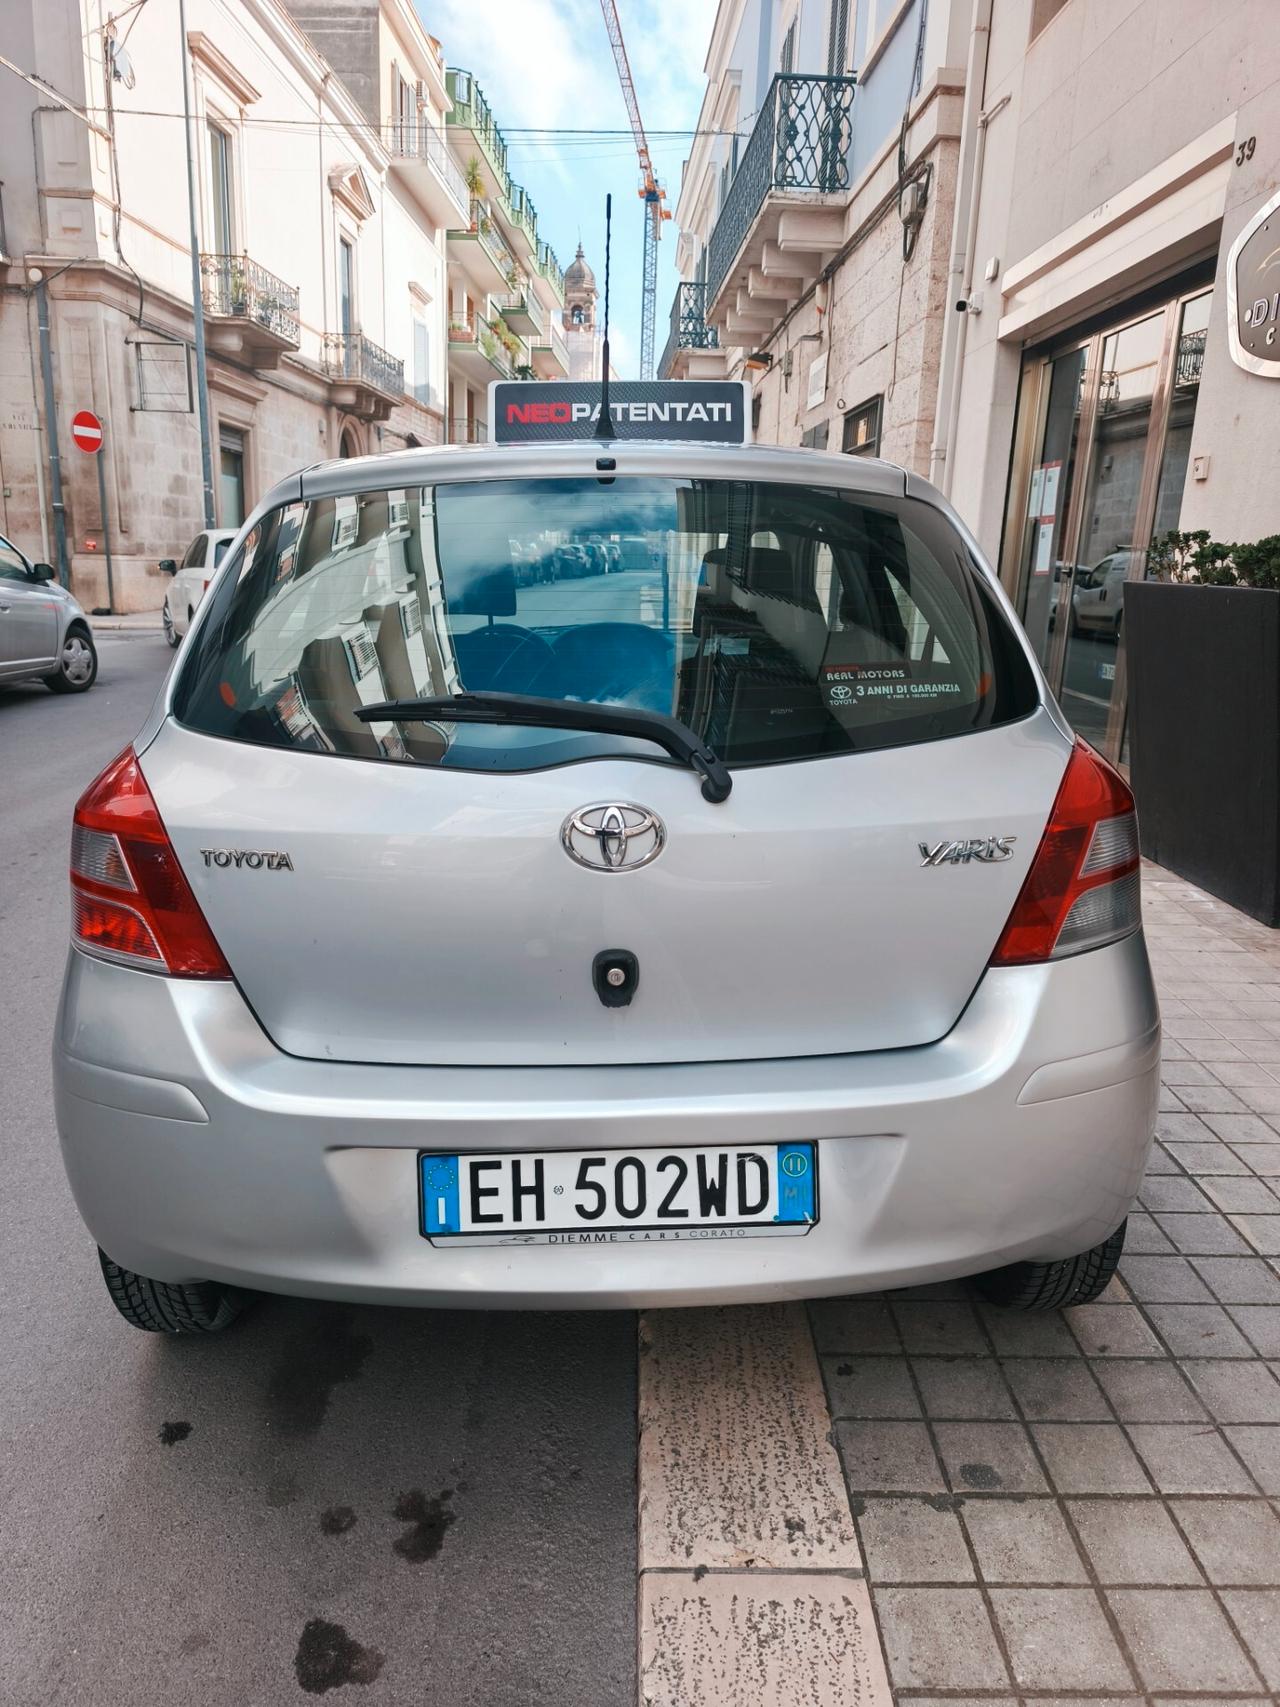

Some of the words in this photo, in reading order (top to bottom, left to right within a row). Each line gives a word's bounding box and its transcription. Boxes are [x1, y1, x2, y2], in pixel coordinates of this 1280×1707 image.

[1235, 136, 1256, 167] 39
[826, 671, 855, 681] REAL
[857, 670, 905, 679] MOTORS
[856, 685, 865, 696] 3
[867, 685, 894, 695] ANNI
[896, 685, 908, 694] DI
[910, 683, 961, 693] GARANZIA
[829, 698, 858, 706] TOYOTA
[200, 848, 294, 871] TOYOTA
[468, 1158, 546, 1224] EH
[574, 1152, 771, 1220] 502WD
[548, 1232, 618, 1243] DIEMME
[689, 1228, 746, 1238] CORATO
